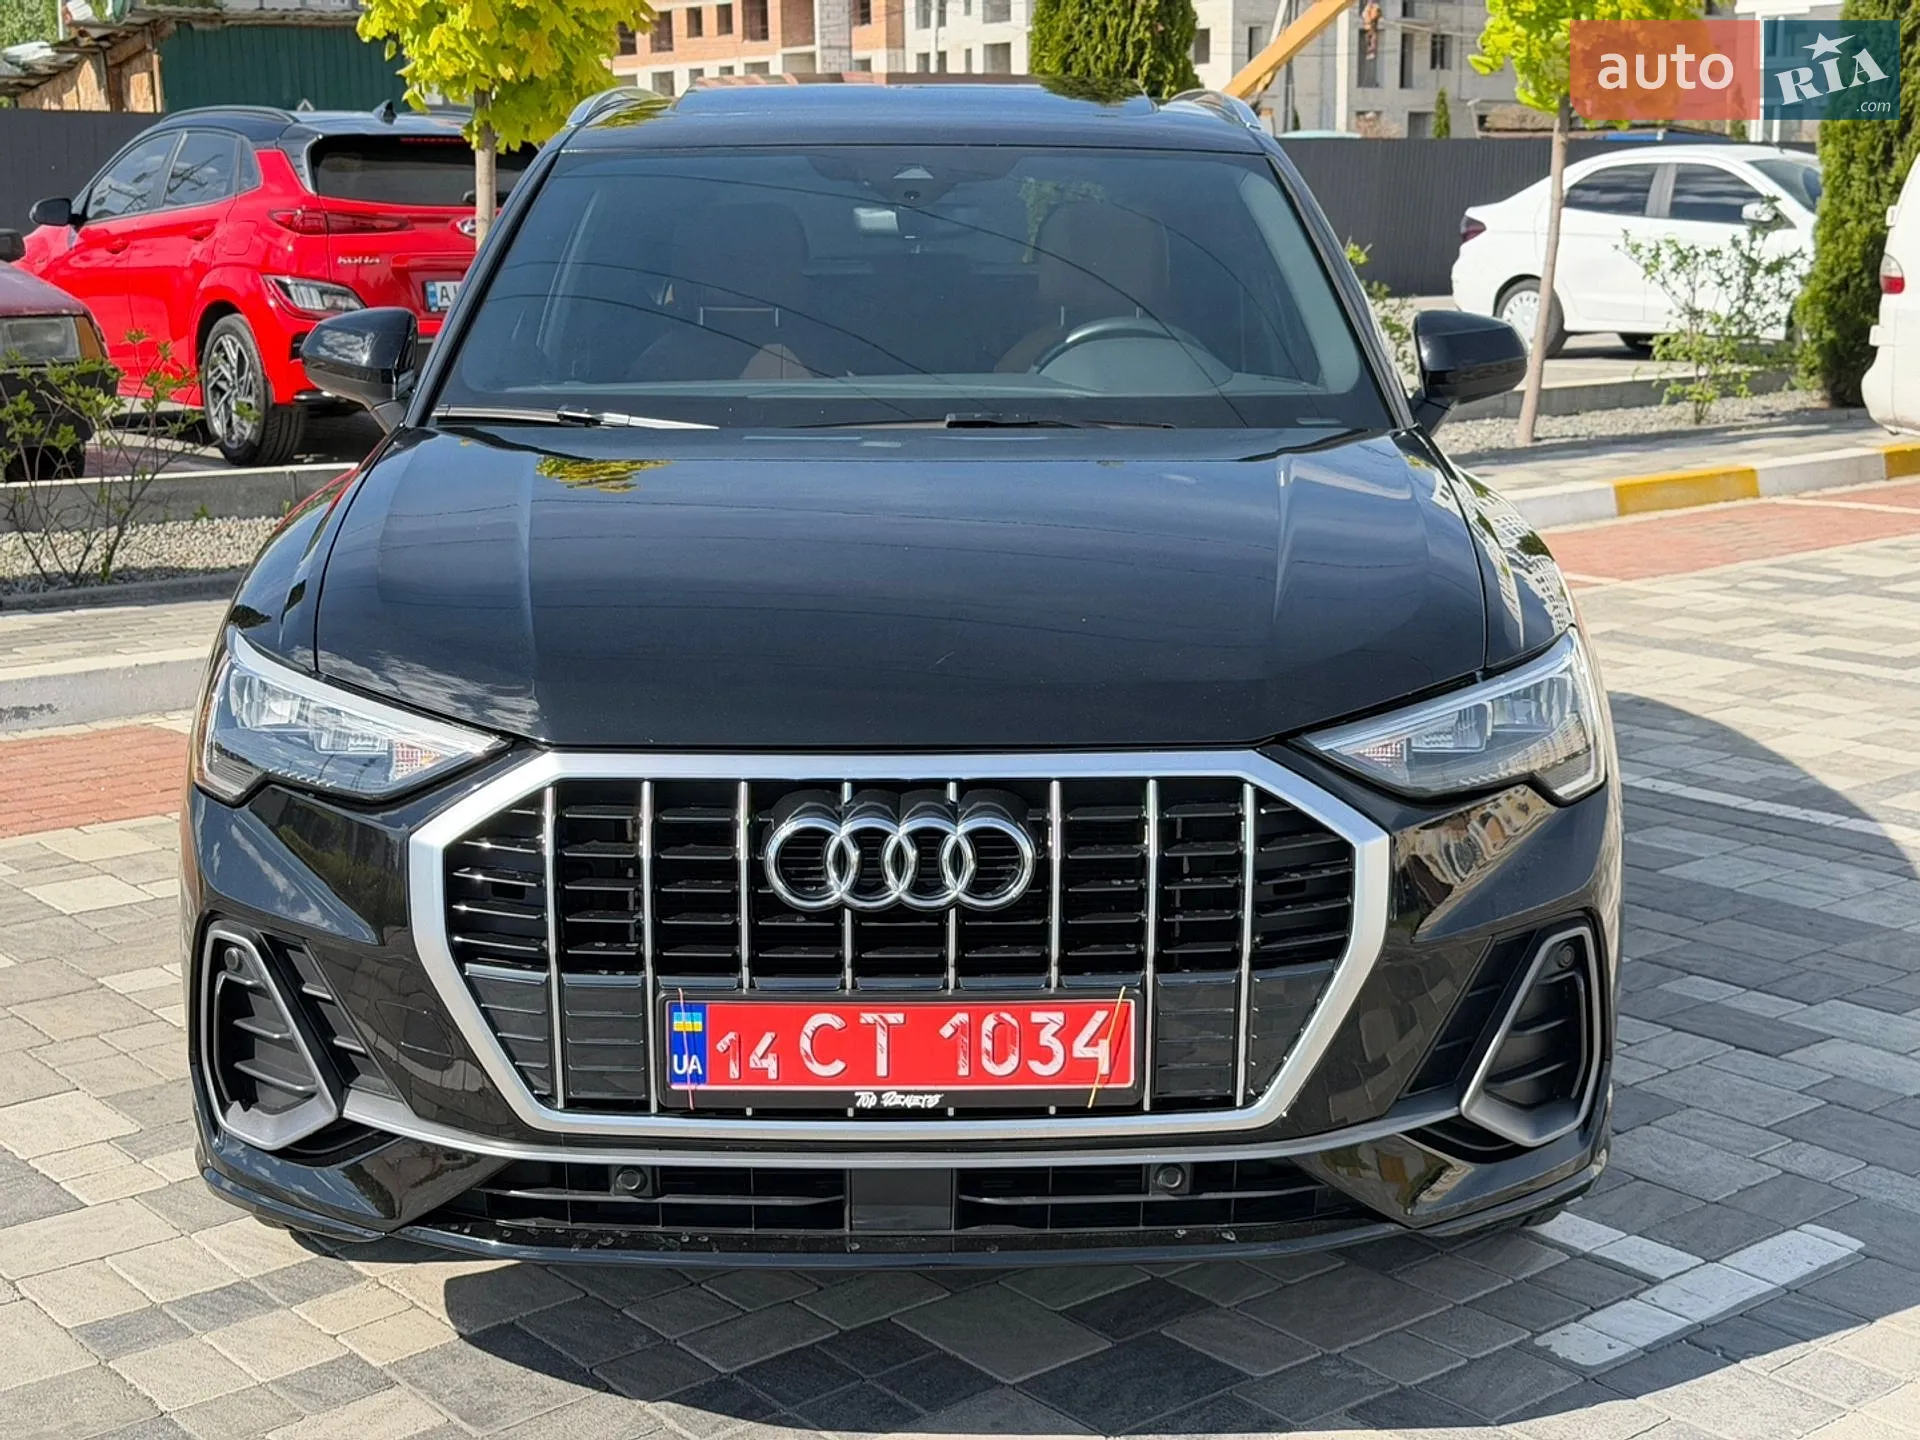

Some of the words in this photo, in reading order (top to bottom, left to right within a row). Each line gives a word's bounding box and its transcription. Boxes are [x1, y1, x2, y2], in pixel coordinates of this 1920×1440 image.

[673, 1054, 703, 1075] UA
[716, 1031, 779, 1080] 14
[800, 1012, 905, 1078] CT
[938, 1010, 1113, 1077] 1034
